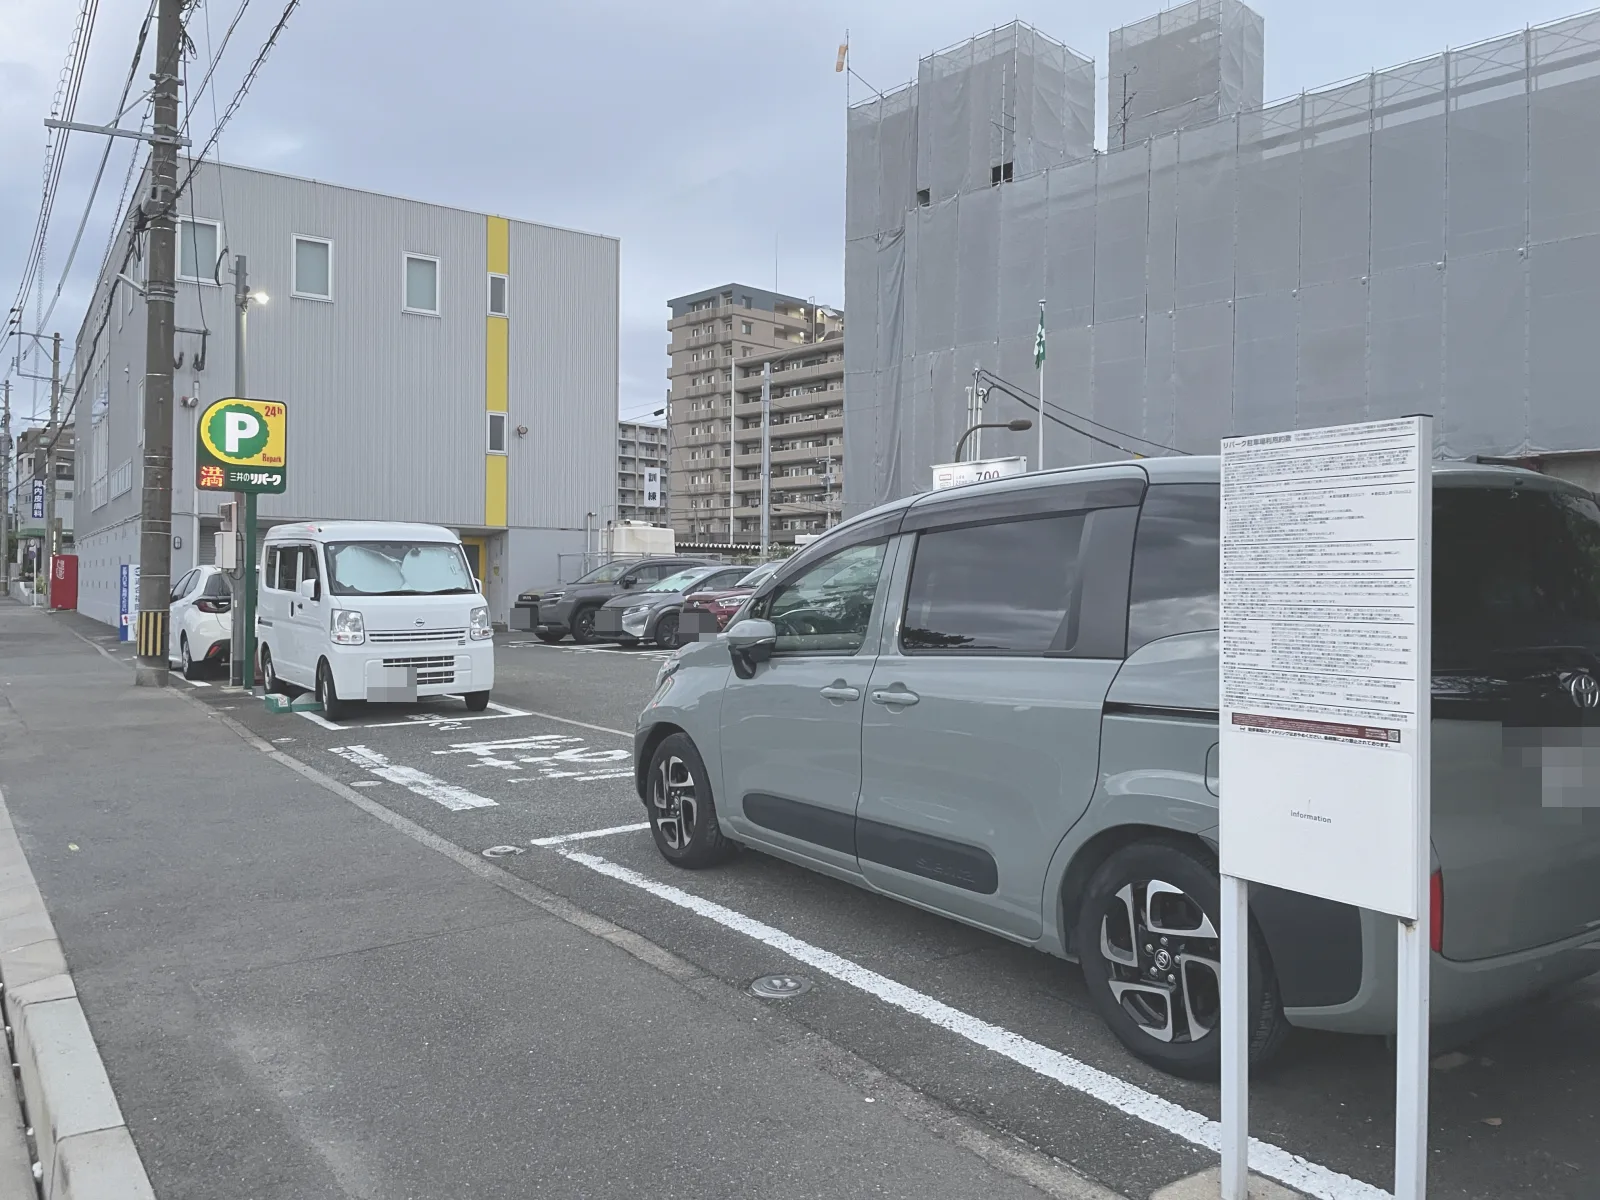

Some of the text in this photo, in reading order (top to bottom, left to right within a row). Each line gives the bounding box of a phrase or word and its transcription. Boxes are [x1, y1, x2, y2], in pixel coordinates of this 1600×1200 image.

[225, 411, 260, 453] P
[201, 466, 224, 487] 満
[1290, 810, 1332, 823] Information
